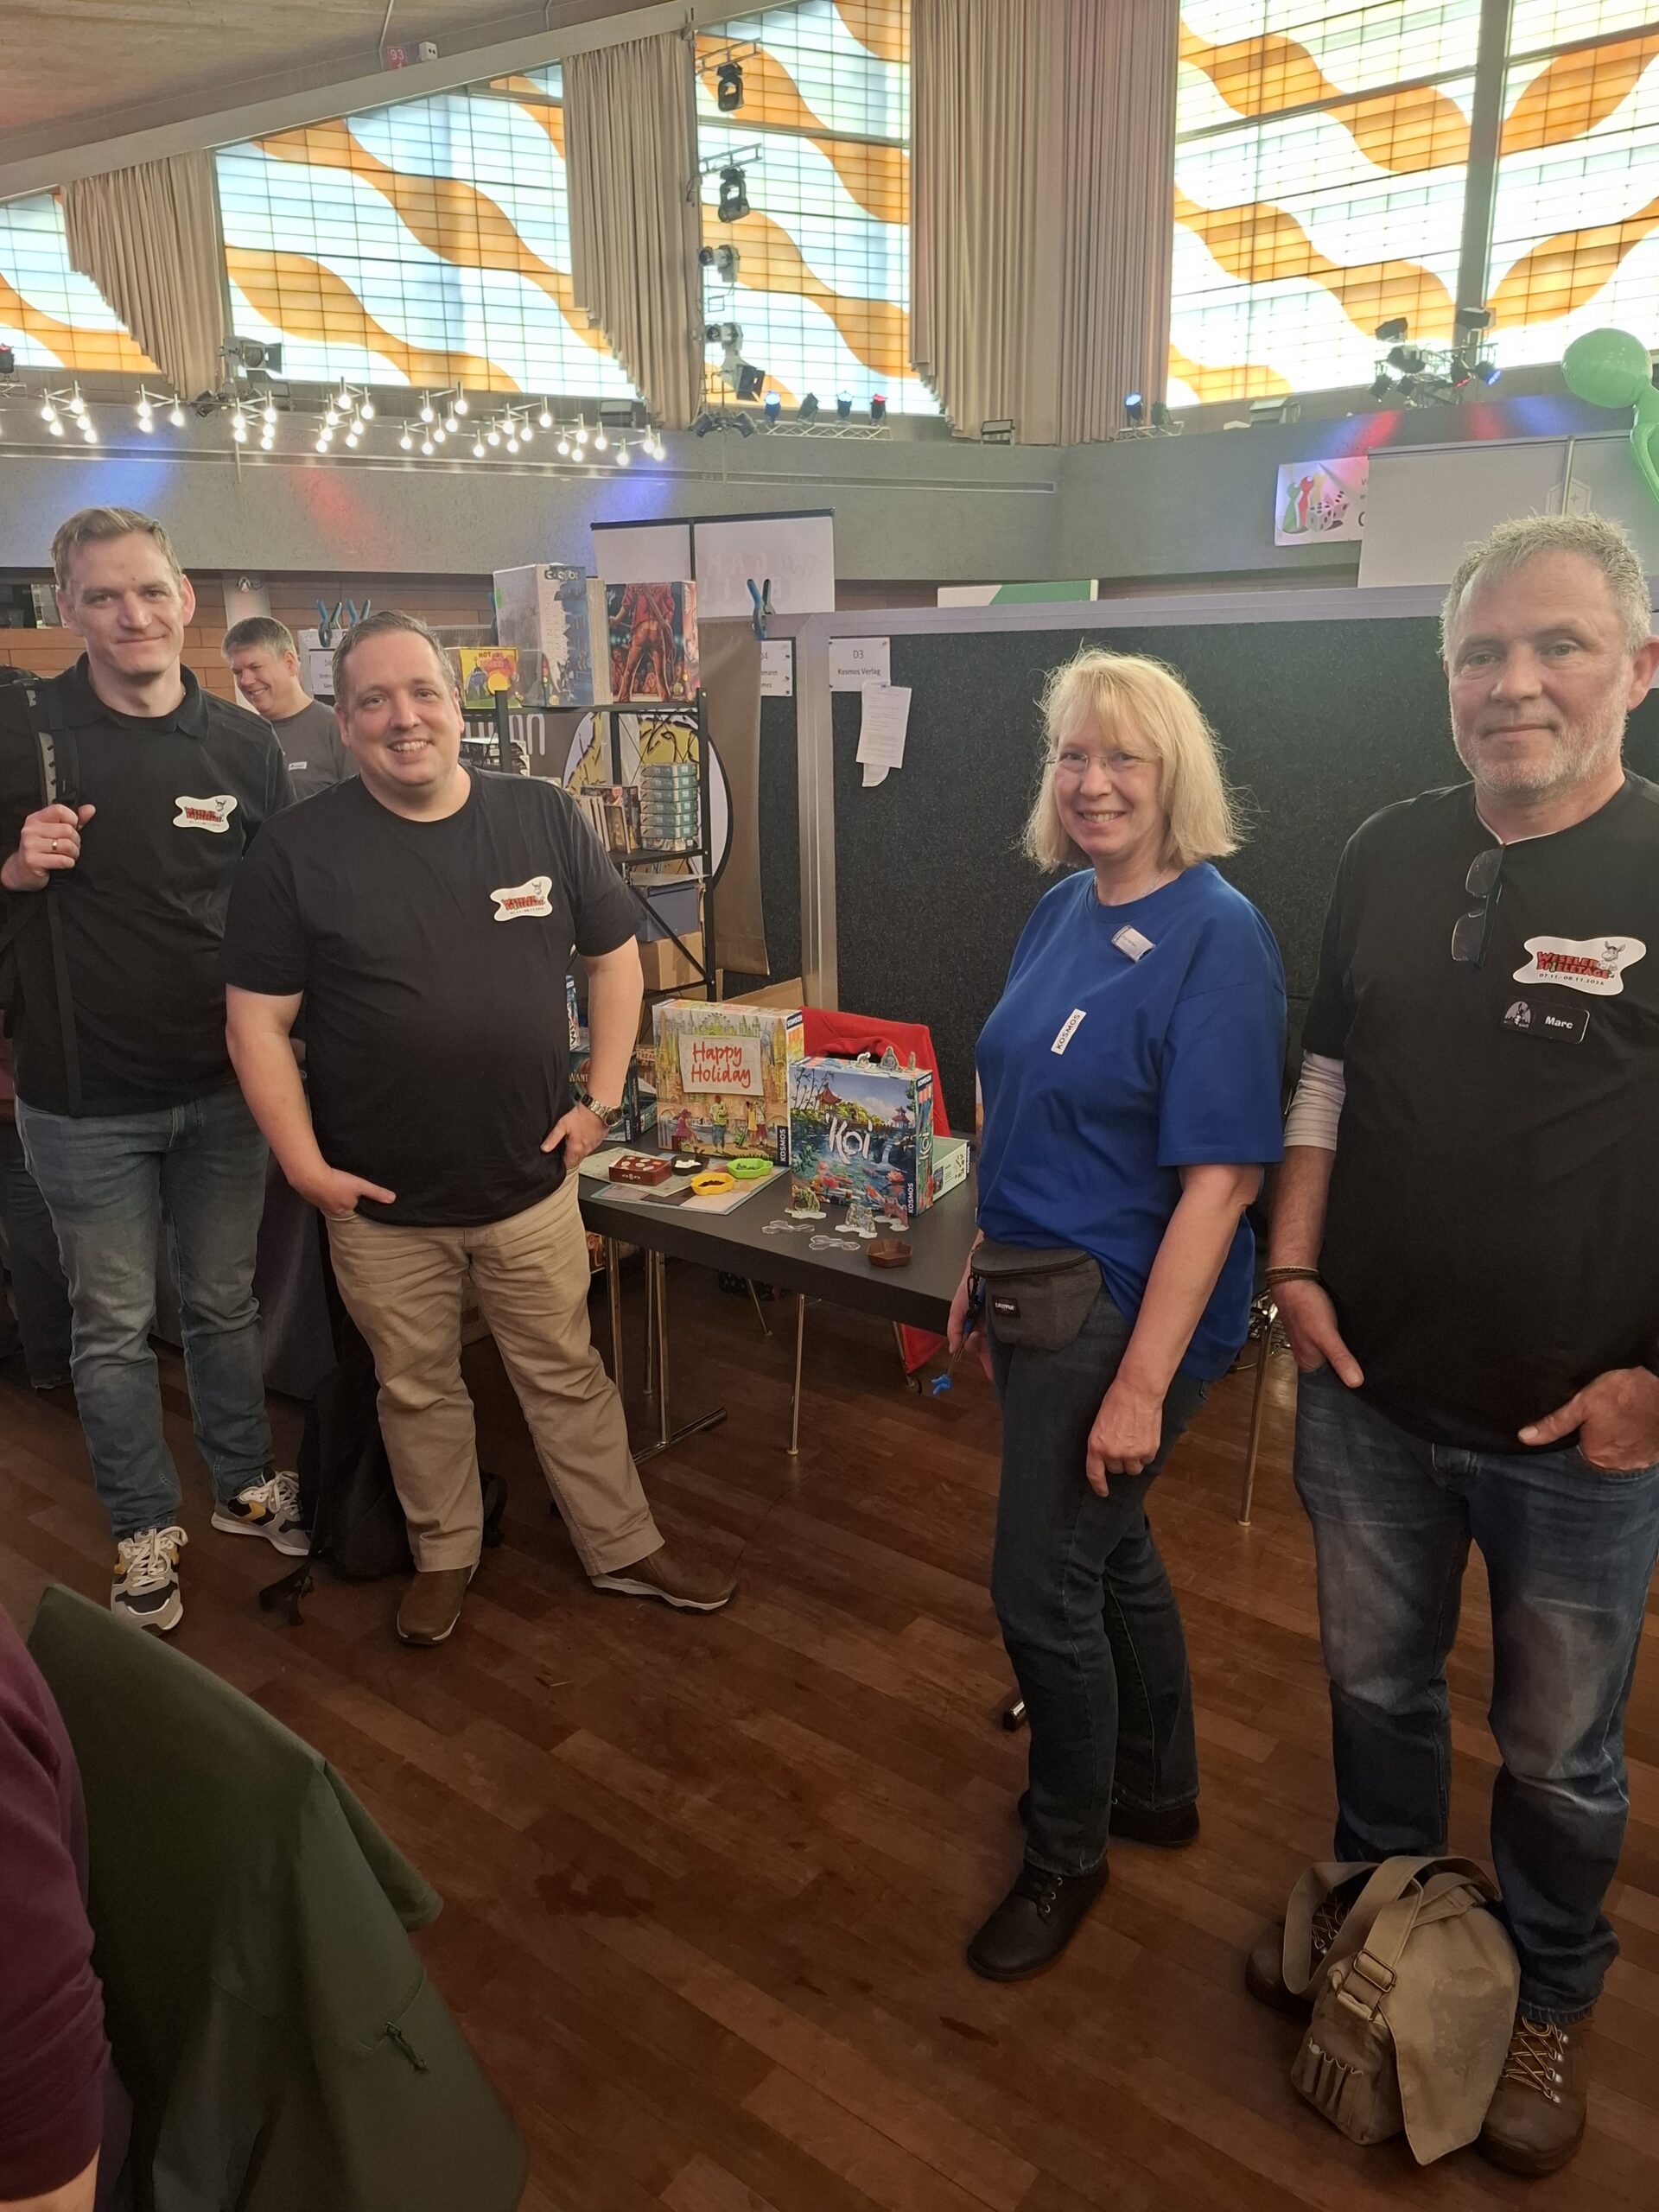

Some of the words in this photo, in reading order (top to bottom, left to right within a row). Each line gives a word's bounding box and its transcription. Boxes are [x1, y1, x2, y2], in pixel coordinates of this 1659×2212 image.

[390, 48, 404, 60] 93
[853, 650, 864, 659] D3
[862, 668, 880, 677] Verlag
[1056, 1014, 1080, 1049] KOSMOS
[1545, 1016, 1573, 1029] Marc
[692, 1041, 742, 1067] Happy
[691, 1064, 751, 1089] Holiday
[825, 1113, 873, 1165] Koi
